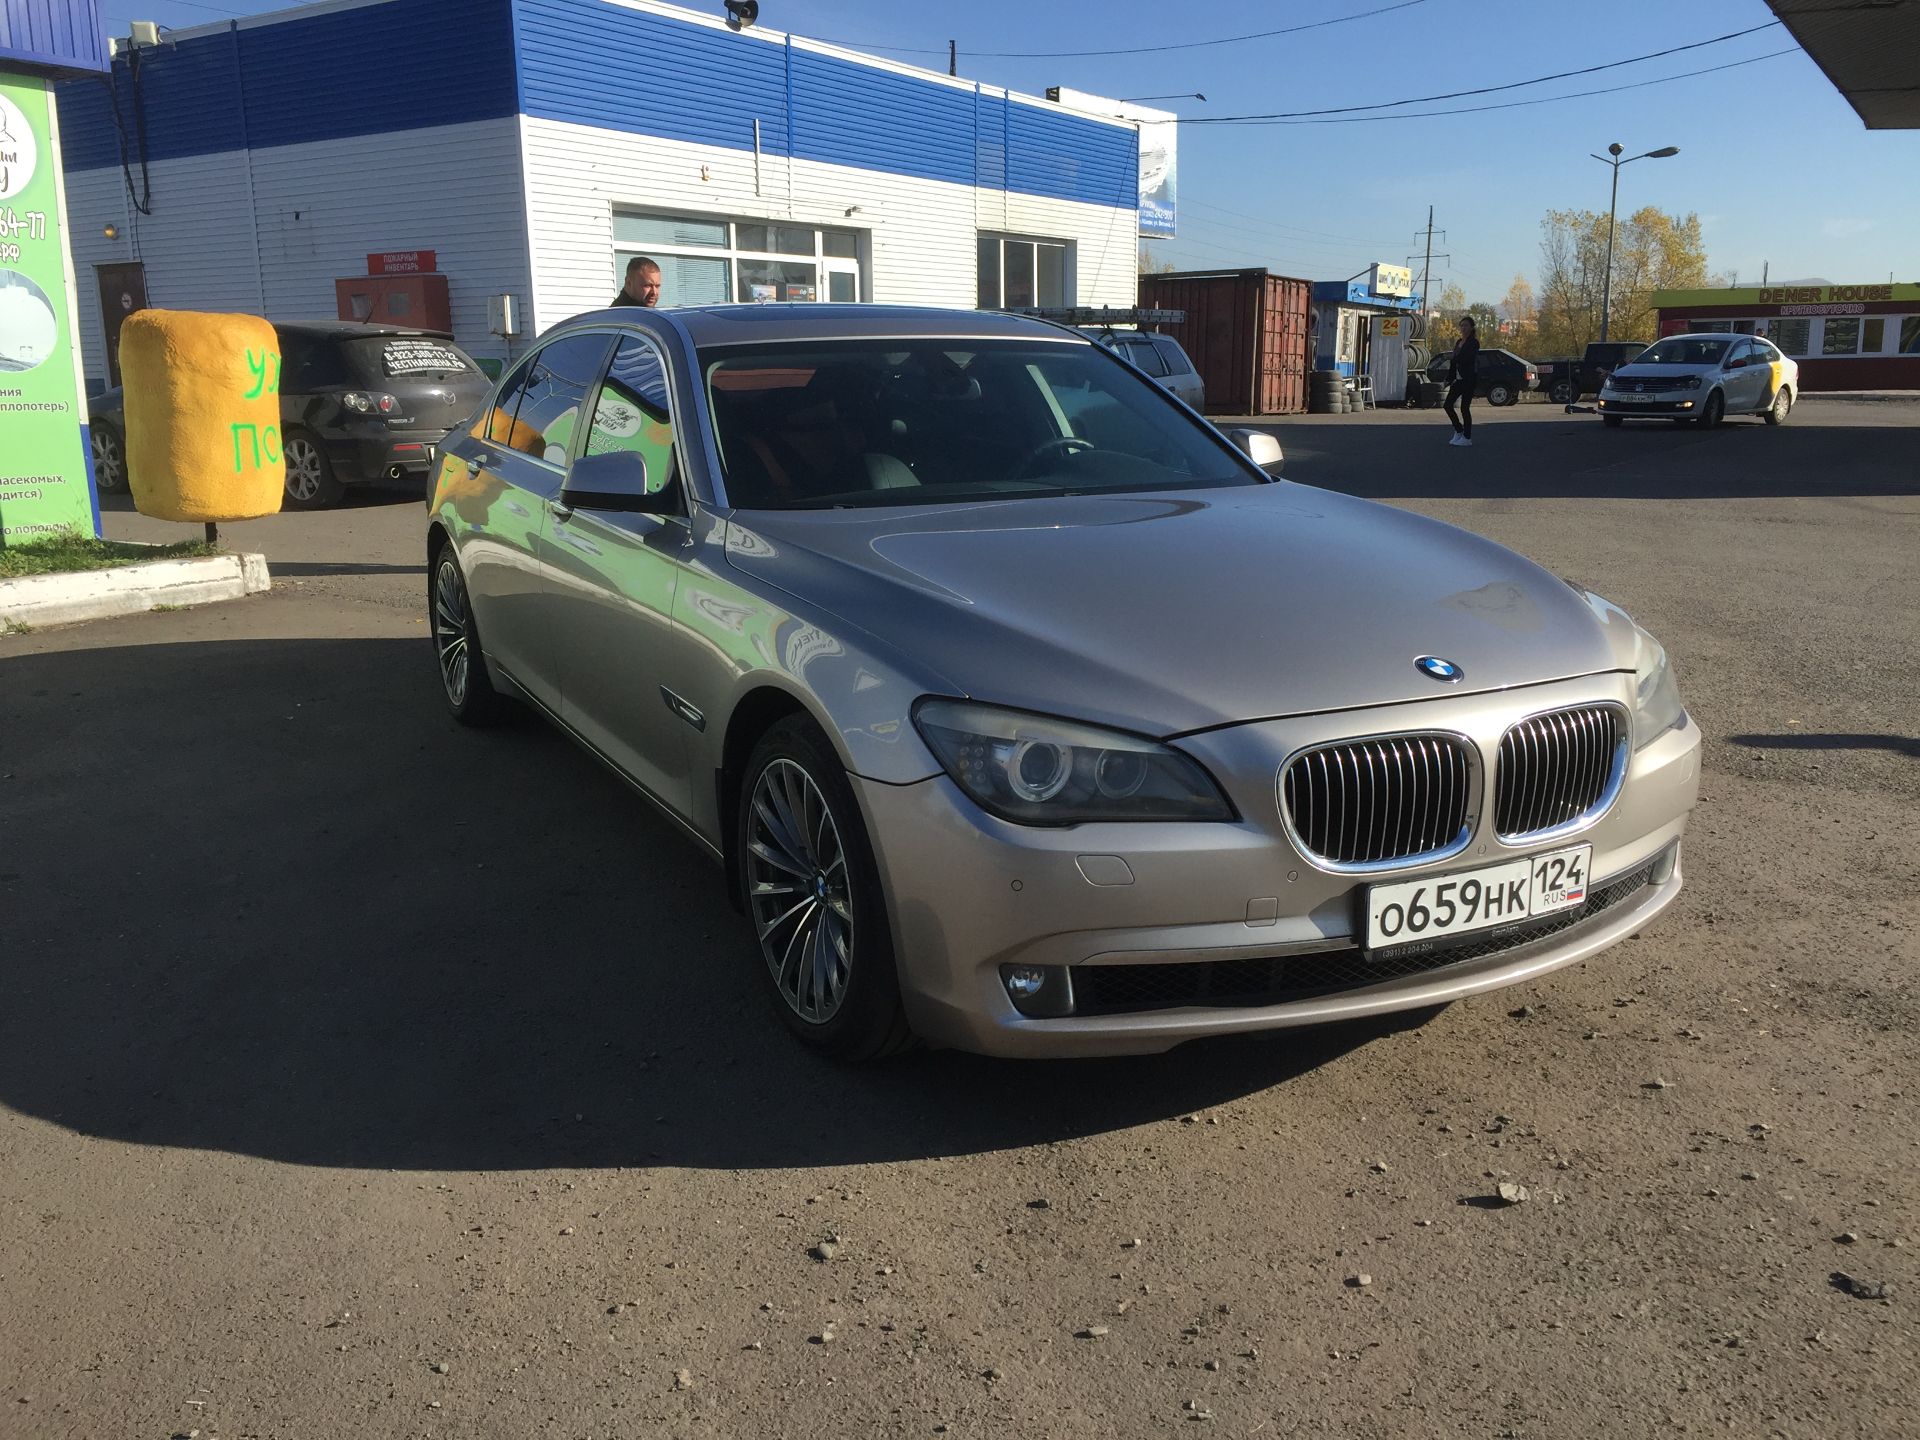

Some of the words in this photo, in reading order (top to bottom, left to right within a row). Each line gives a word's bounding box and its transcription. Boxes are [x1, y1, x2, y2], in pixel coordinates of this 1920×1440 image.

[384, 252, 418, 263] ПОЖАРНЫЙ
[385, 262, 419, 272] ИНВЕНТАРЬ
[1759, 287, 1822, 303] DENER
[1828, 285, 1893, 301] HOUSE
[1780, 303, 1865, 316] КРУГЛОСУТОЧНО
[1383, 319, 1399, 330] 24
[386, 358, 466, 370] ЧЕСТНАЯЦЕНА.РФ
[0, 401, 70, 413] плопотерь)
[1379, 877, 1527, 938] О659НК
[1534, 854, 1584, 894] 124
[1543, 890, 1567, 906] RUS
[1382, 950, 1401, 959] (391)
[1407, 945, 1421, 956] 204
